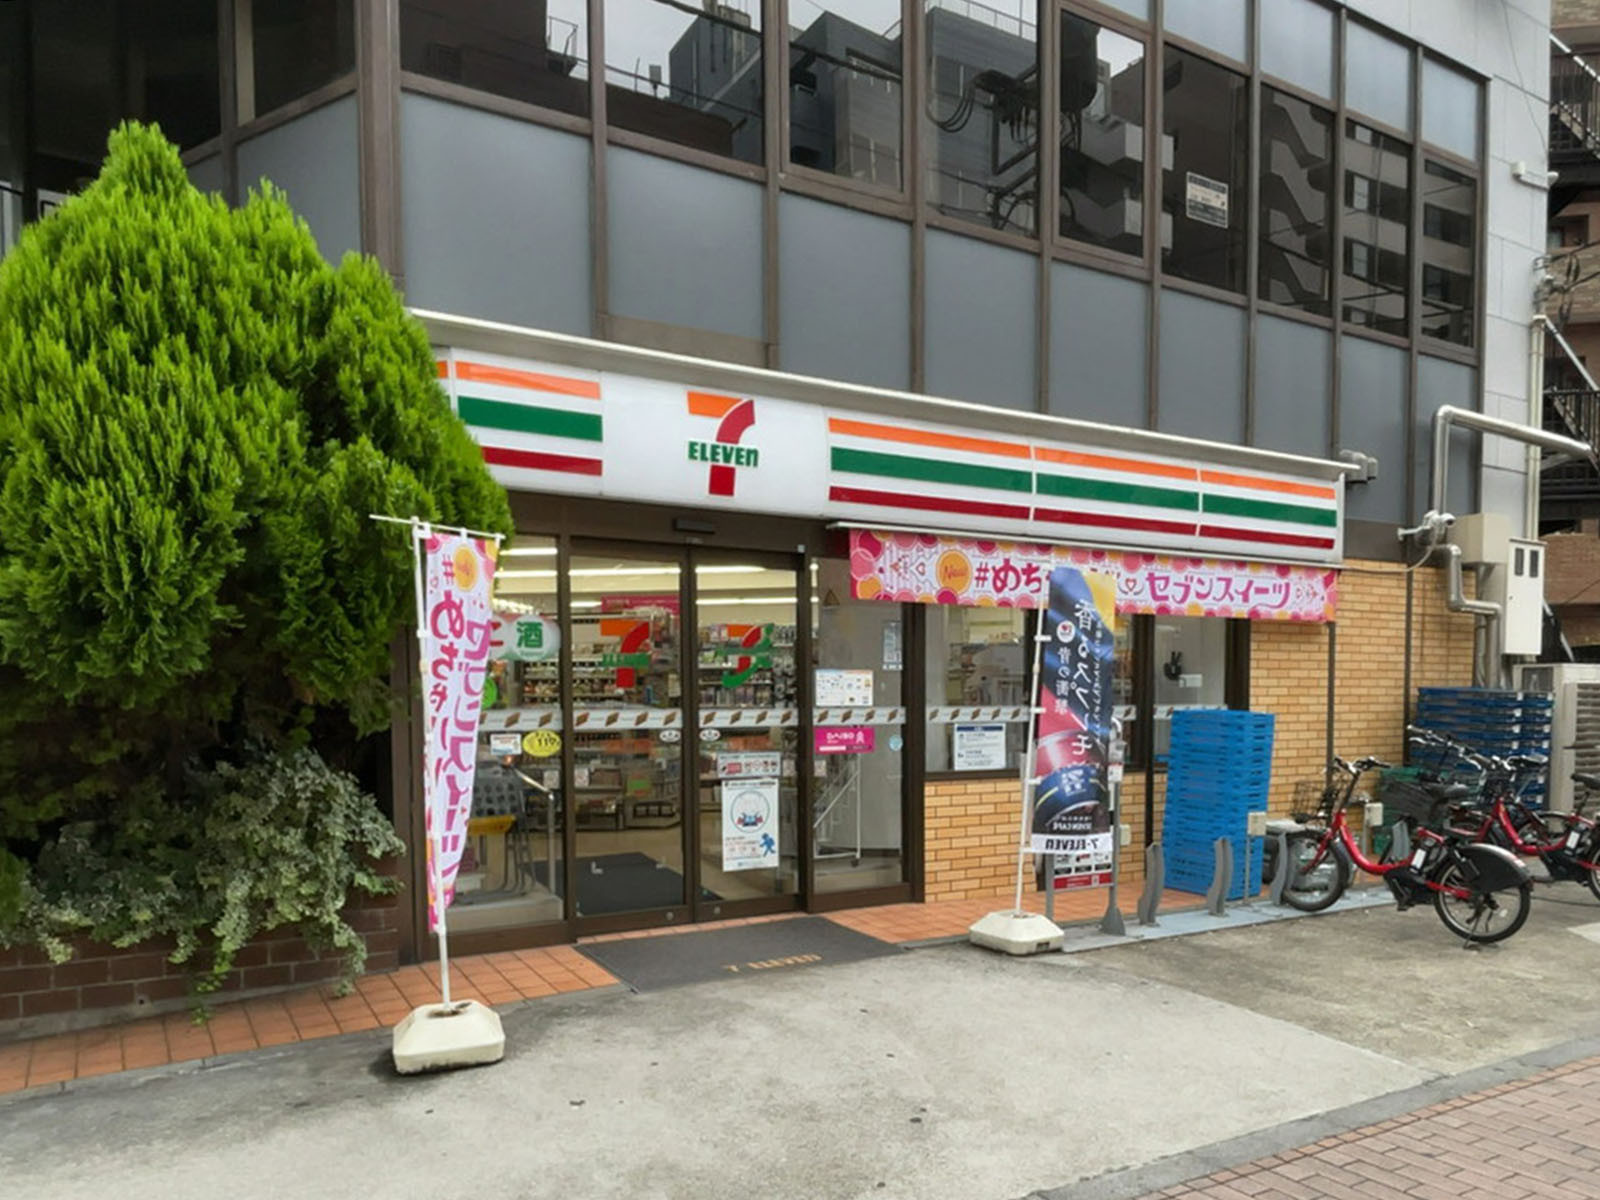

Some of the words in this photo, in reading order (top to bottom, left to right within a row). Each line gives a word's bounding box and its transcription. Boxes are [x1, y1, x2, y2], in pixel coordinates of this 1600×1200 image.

[687, 391, 756, 497] 7
[1145, 571, 1291, 610] セブンスイーツ
[516, 621, 543, 648] 酒
